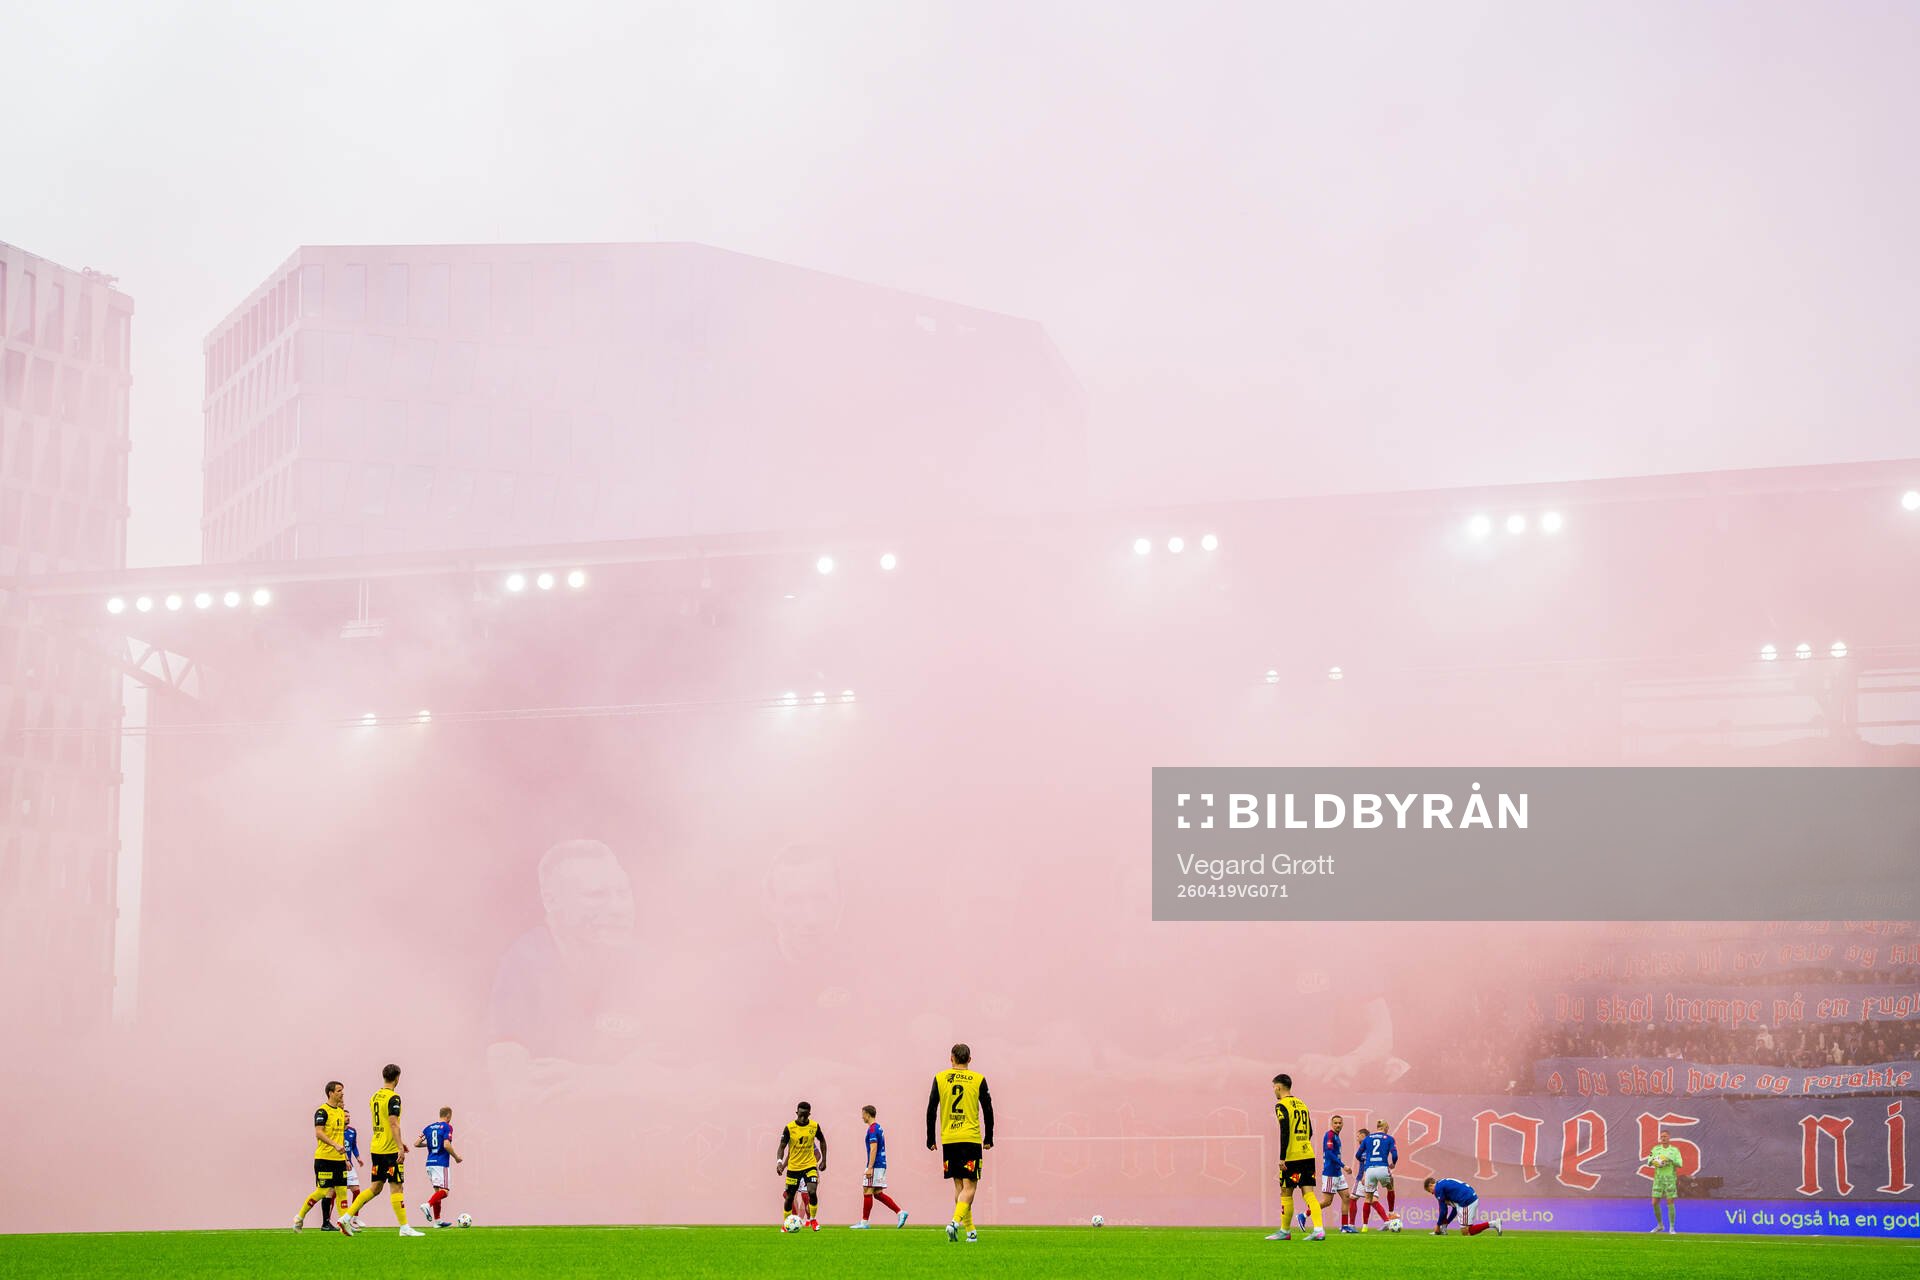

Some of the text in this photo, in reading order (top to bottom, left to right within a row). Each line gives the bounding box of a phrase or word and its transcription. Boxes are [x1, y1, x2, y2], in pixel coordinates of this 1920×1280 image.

[1554, 991, 1585, 1022] Du
[1597, 993, 1654, 1024] skal
[1665, 992, 1762, 1030] trampe
[1773, 991, 1805, 1029] på
[1816, 997, 1850, 1019] en
[1576, 1066, 1609, 1097] Du
[1617, 1064, 1675, 1096] skal
[1687, 1066, 1746, 1093] hate
[1756, 1073, 1791, 1095] og
[1803, 1066, 1912, 1094] forakte
[952, 1084, 964, 1113] 2
[1294, 1110, 1308, 1134] 29
[431, 1130, 438, 1147] 8
[1372, 1139, 1380, 1155] 2
[1725, 1209, 1746, 1225] Vil
[1752, 1210, 1774, 1225] du
[1780, 1209, 1823, 1229] også
[1828, 1211, 1850, 1226] ha
[1855, 1214, 1877, 1226] en
